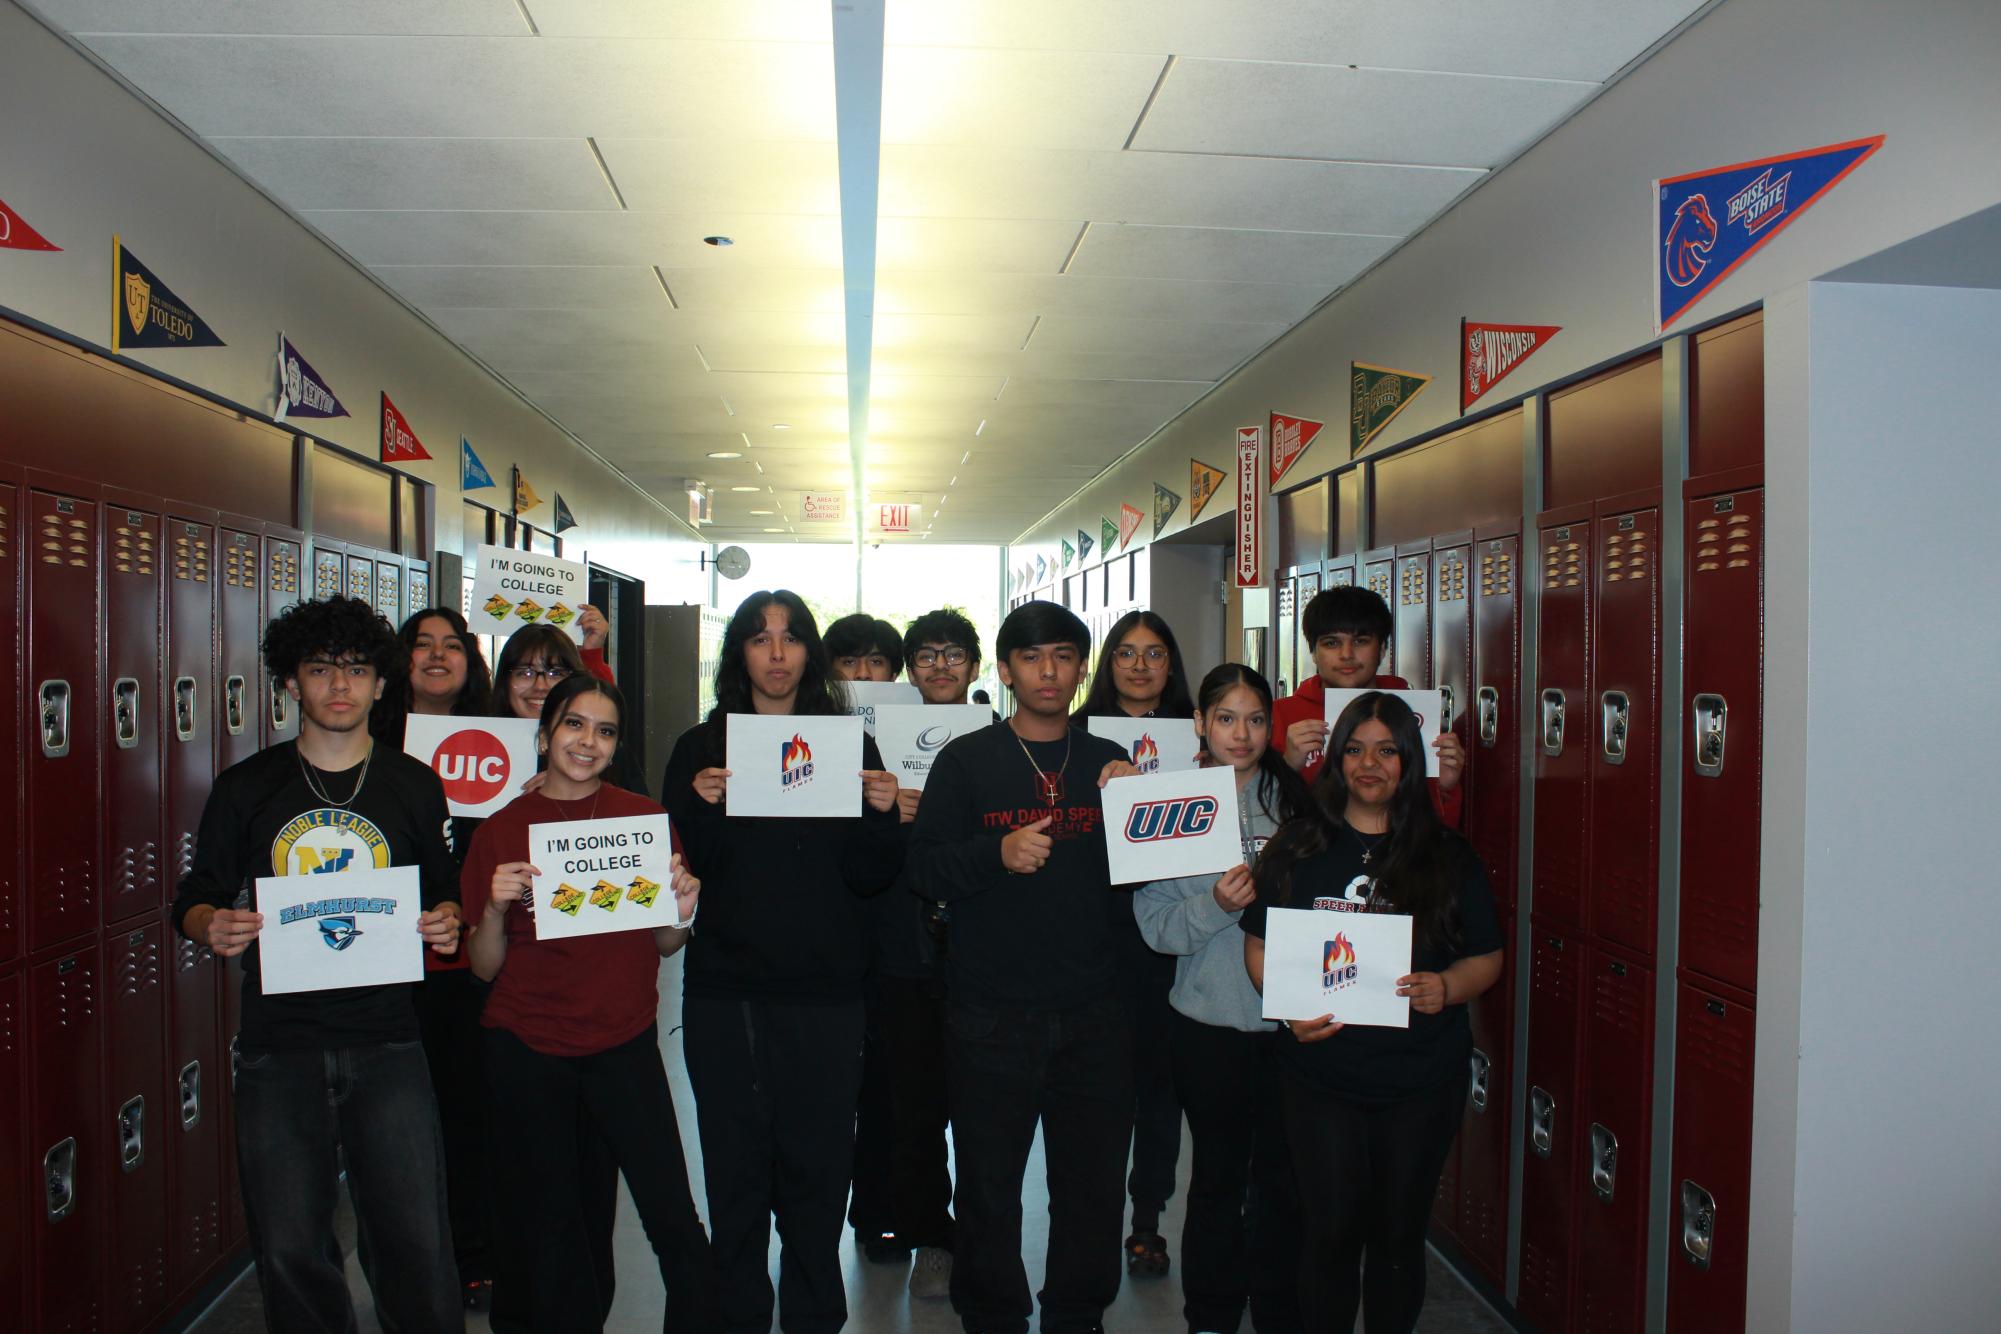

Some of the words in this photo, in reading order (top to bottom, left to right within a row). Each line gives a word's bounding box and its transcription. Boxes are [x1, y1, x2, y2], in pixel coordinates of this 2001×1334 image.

[1731, 178, 1766, 219] BOISE
[1747, 182, 1785, 223] STATE
[150, 304, 193, 341] TOLEDO
[1484, 331, 1536, 385] WISCONSIN
[1240, 440, 1256, 451] FIRE
[880, 505, 911, 527] EXIT
[1244, 452, 1252, 573] EXTINGUISHER
[490, 558, 509, 572] I'M
[513, 562, 555, 578] GOING
[558, 569, 575, 582] TO
[501, 578, 564, 596] COLLEGE
[858, 706, 875, 716] DO
[439, 753, 504, 783] UIC
[782, 762, 814, 786] UIC
[902, 760, 931, 770] Wilbu
[782, 777, 813, 793] FLAMES
[984, 810, 1013, 827] ITW
[1018, 807, 1064, 823] DAVID
[1125, 797, 1218, 842] UIC
[281, 812, 325, 846] NOBLE
[330, 811, 383, 849] LEAGUE
[547, 838, 569, 853] I'M
[575, 833, 627, 851] GOING
[632, 831, 653, 846] TO
[564, 854, 642, 874] COLLEGE
[279, 897, 397, 925] ELMHURST
[1313, 899, 1355, 913] SPEER
[1322, 964, 1358, 988] UIC
